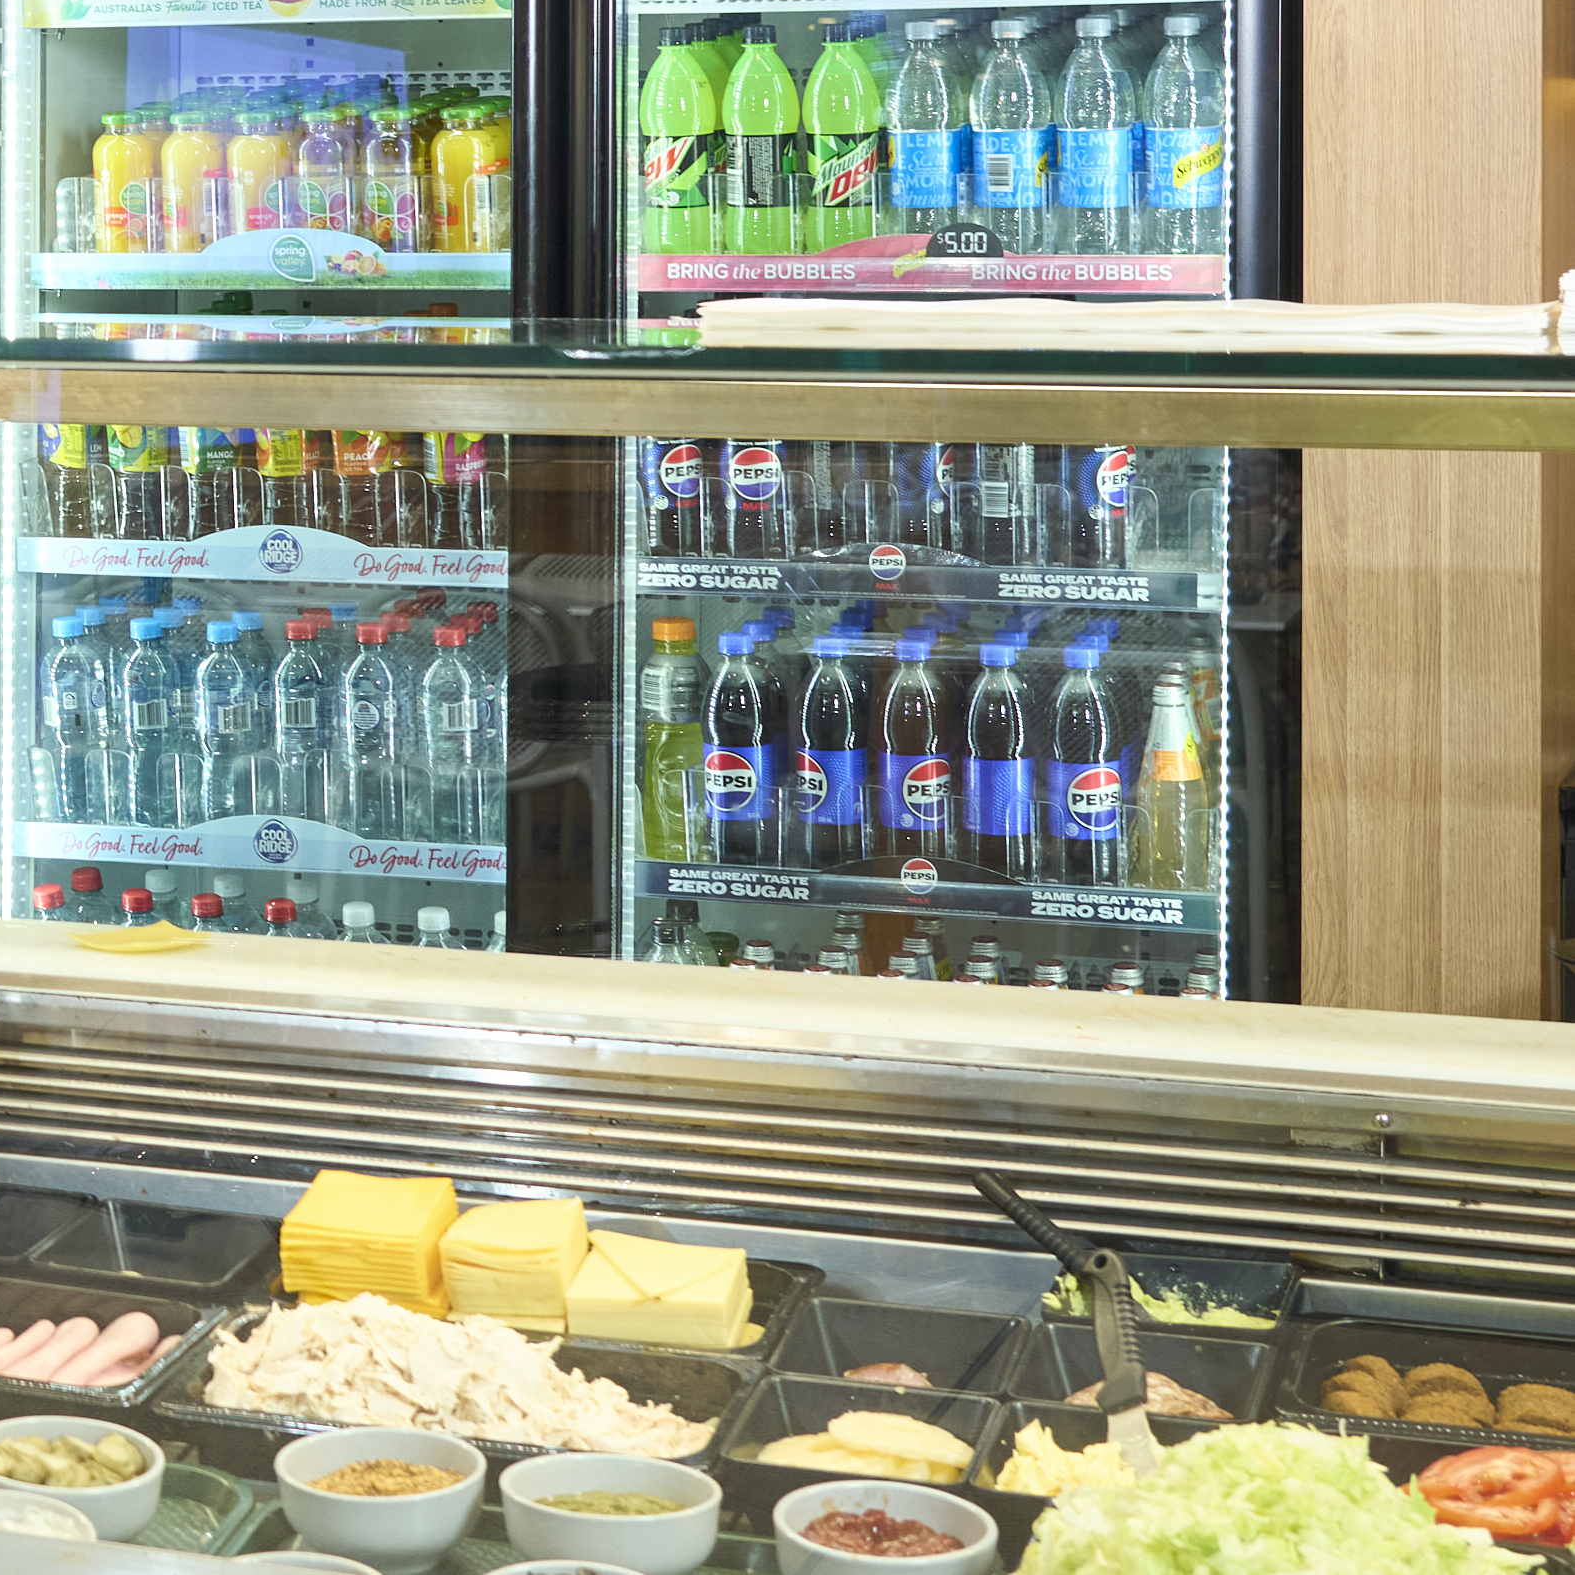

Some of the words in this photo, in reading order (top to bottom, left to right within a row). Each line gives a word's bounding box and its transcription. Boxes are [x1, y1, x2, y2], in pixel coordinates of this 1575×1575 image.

[94, 3, 161, 14] AUSTRALIA'S
[166, 0, 209, 15] Favourite
[212, 2, 238, 12] ICED
[937, 231, 988, 254] $5.00
[274, 245, 306, 260] spring
[667, 263, 729, 280] BRING
[732, 263, 761, 280] the
[764, 263, 856, 281] BUBBLES
[972, 263, 1037, 281] BRING
[1041, 264, 1072, 281] the
[1075, 264, 1173, 282] BUBBLES
[733, 467, 779, 480] PEPSI
[266, 539, 295, 551] COOL
[64, 546, 89, 568] Do
[92, 547, 133, 575] Good.
[137, 548, 166, 568] Feel
[169, 547, 210, 575] Good.
[263, 549, 298, 564] RIDGE
[871, 557, 903, 567] PEPSI
[638, 562, 680, 573] SAME
[680, 563, 729, 574] GREAT
[731, 565, 779, 575] TASTE
[637, 573, 698, 587] ZERO
[700, 575, 779, 590] SUGAR
[903, 871, 935, 881] PEPSI
[1031, 890, 1074, 902] SAME
[1077, 893, 1129, 906] GREAT
[1131, 896, 1183, 909] TASTE
[1030, 902, 1094, 919] ZERO
[1097, 905, 1184, 924] SUGAR
